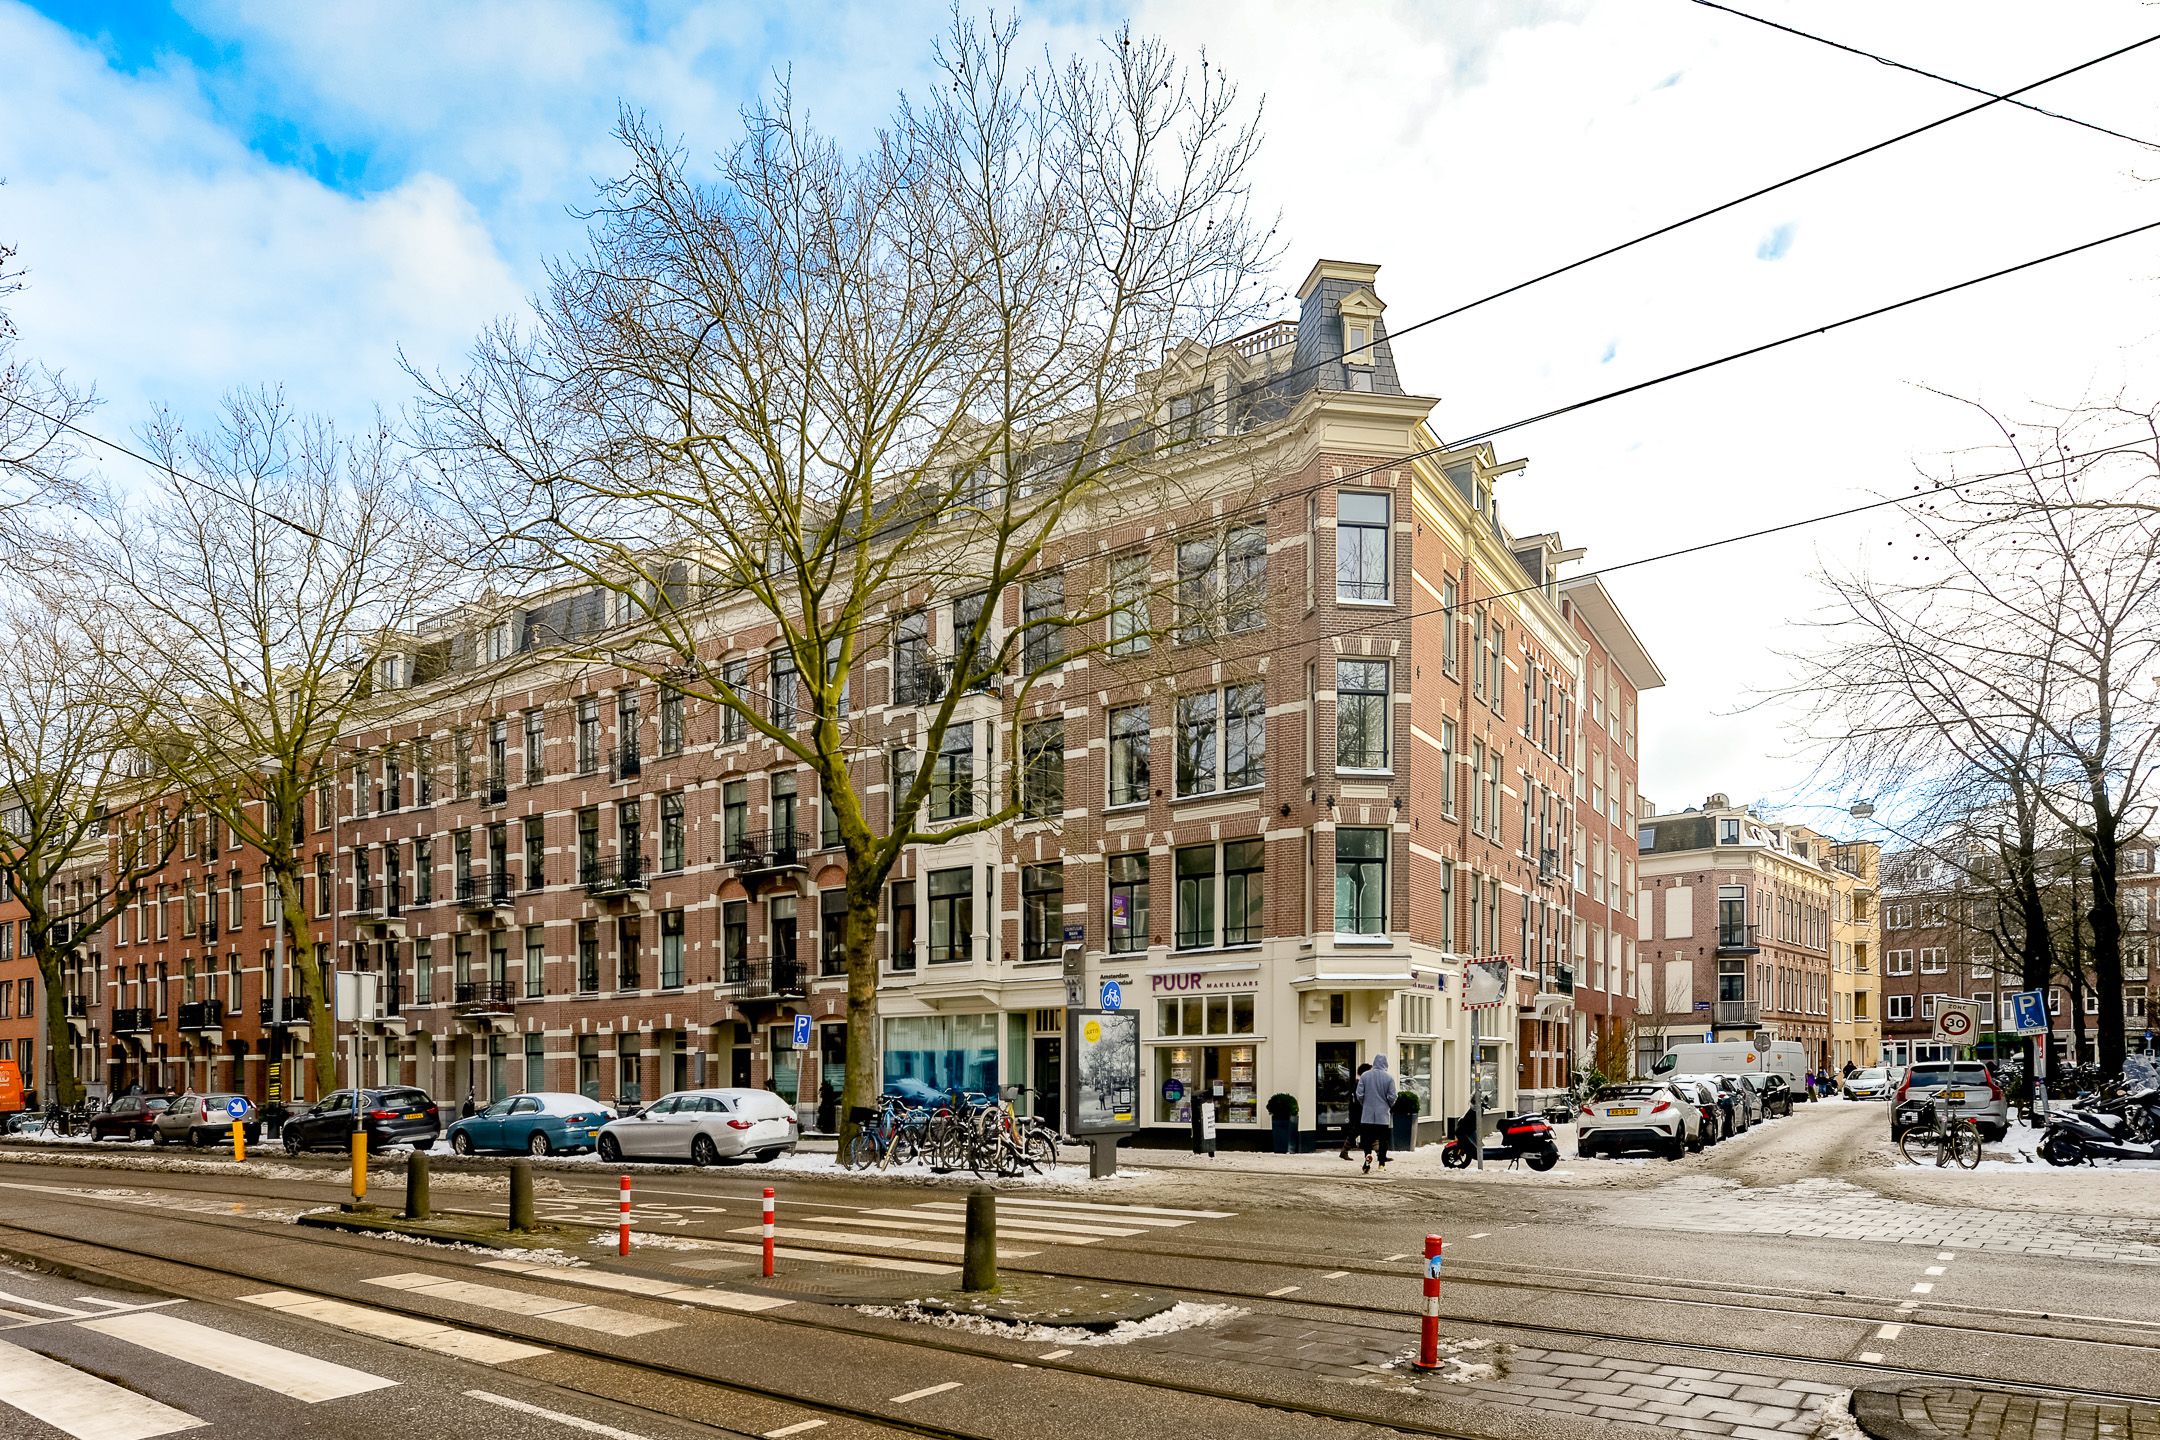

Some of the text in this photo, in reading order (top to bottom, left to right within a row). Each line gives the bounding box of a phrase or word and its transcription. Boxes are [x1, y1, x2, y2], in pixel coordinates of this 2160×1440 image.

[1152, 973, 1202, 991] PUUR
[2018, 995, 2036, 1015] P
[797, 1017, 808, 1032] P
[1946, 1018, 1965, 1028] 30
